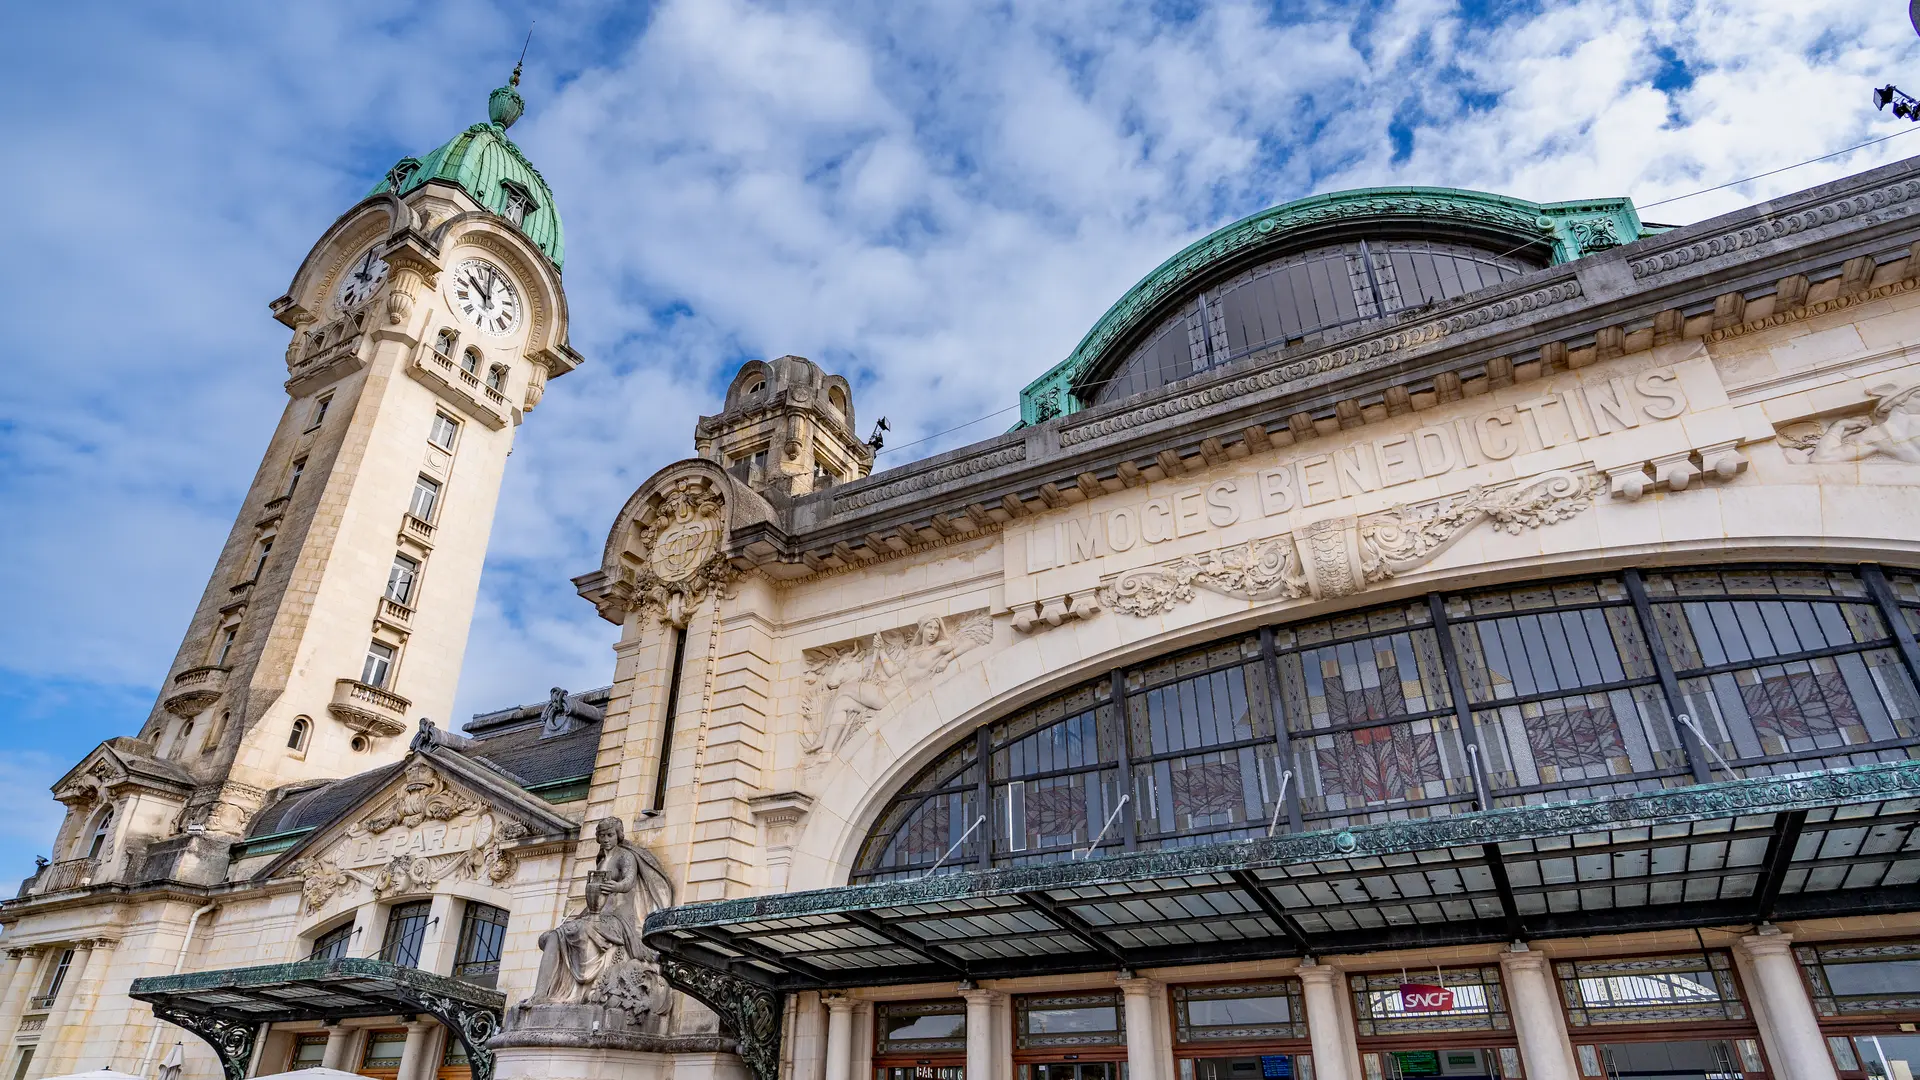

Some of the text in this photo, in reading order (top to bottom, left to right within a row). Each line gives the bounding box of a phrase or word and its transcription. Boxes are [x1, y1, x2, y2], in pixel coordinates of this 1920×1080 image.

[1026, 367, 1688, 576] LIMOGES BENEDICTINS
[1405, 992, 1450, 1008] SNCF
